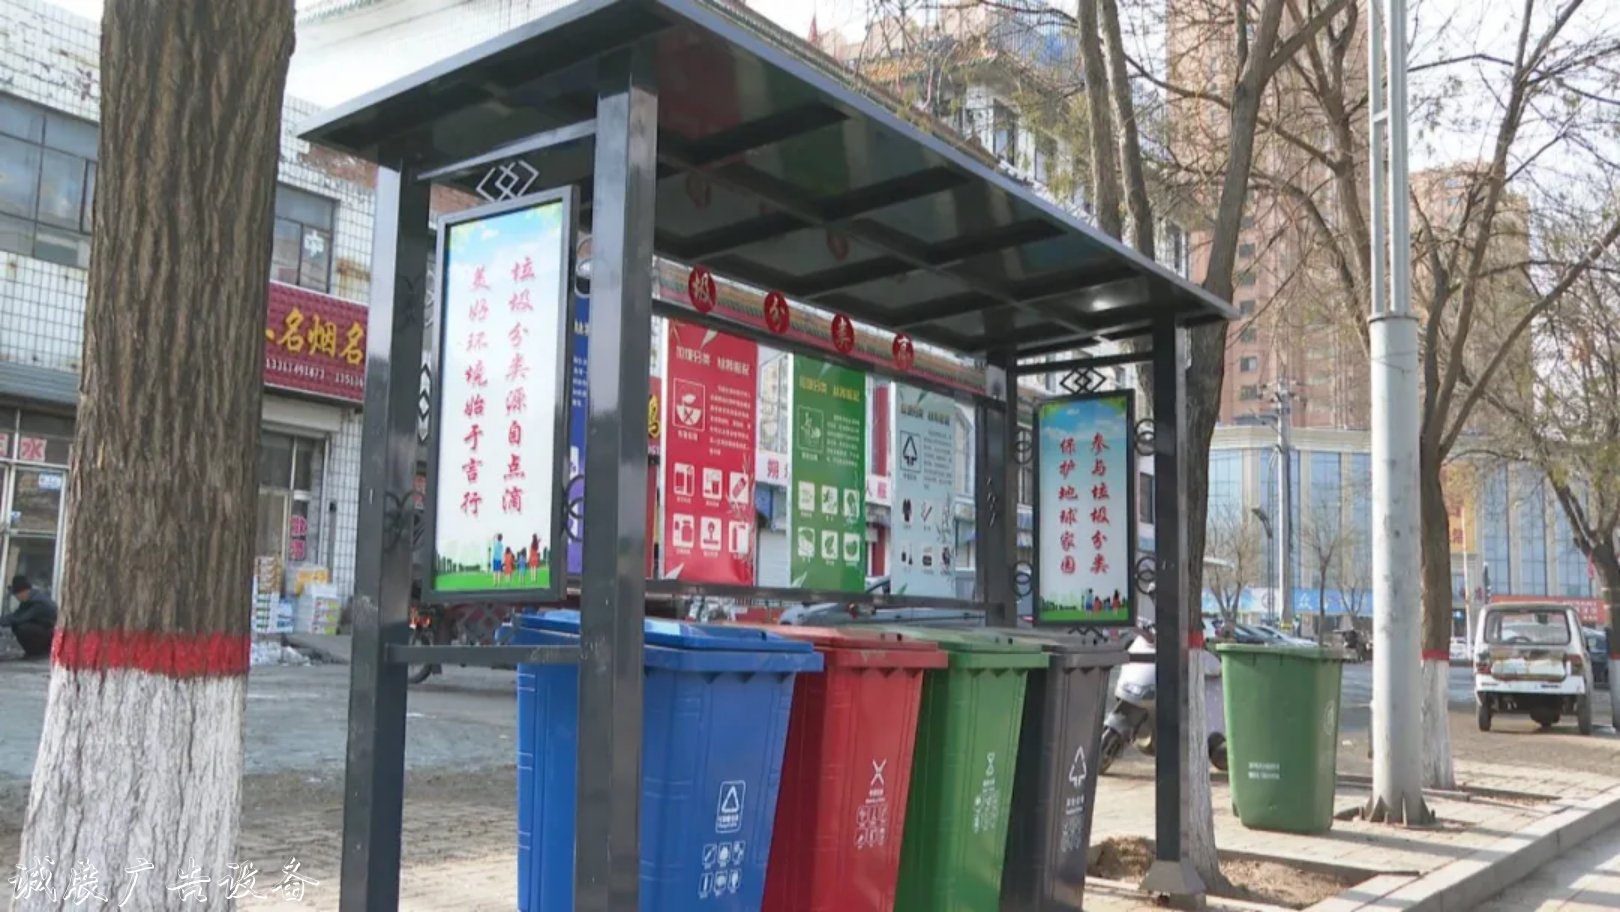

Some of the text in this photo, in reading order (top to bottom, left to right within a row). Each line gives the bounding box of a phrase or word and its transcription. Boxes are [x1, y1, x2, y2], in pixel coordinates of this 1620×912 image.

[265, 305, 364, 365] 名烟名
[460, 264, 491, 517] 美好环境始于言行
[502, 255, 537, 514] 垃圾分类源自点滴
[1058, 436, 1079, 575] 保护地球家园
[1089, 431, 1110, 575] 参与垃圾分类
